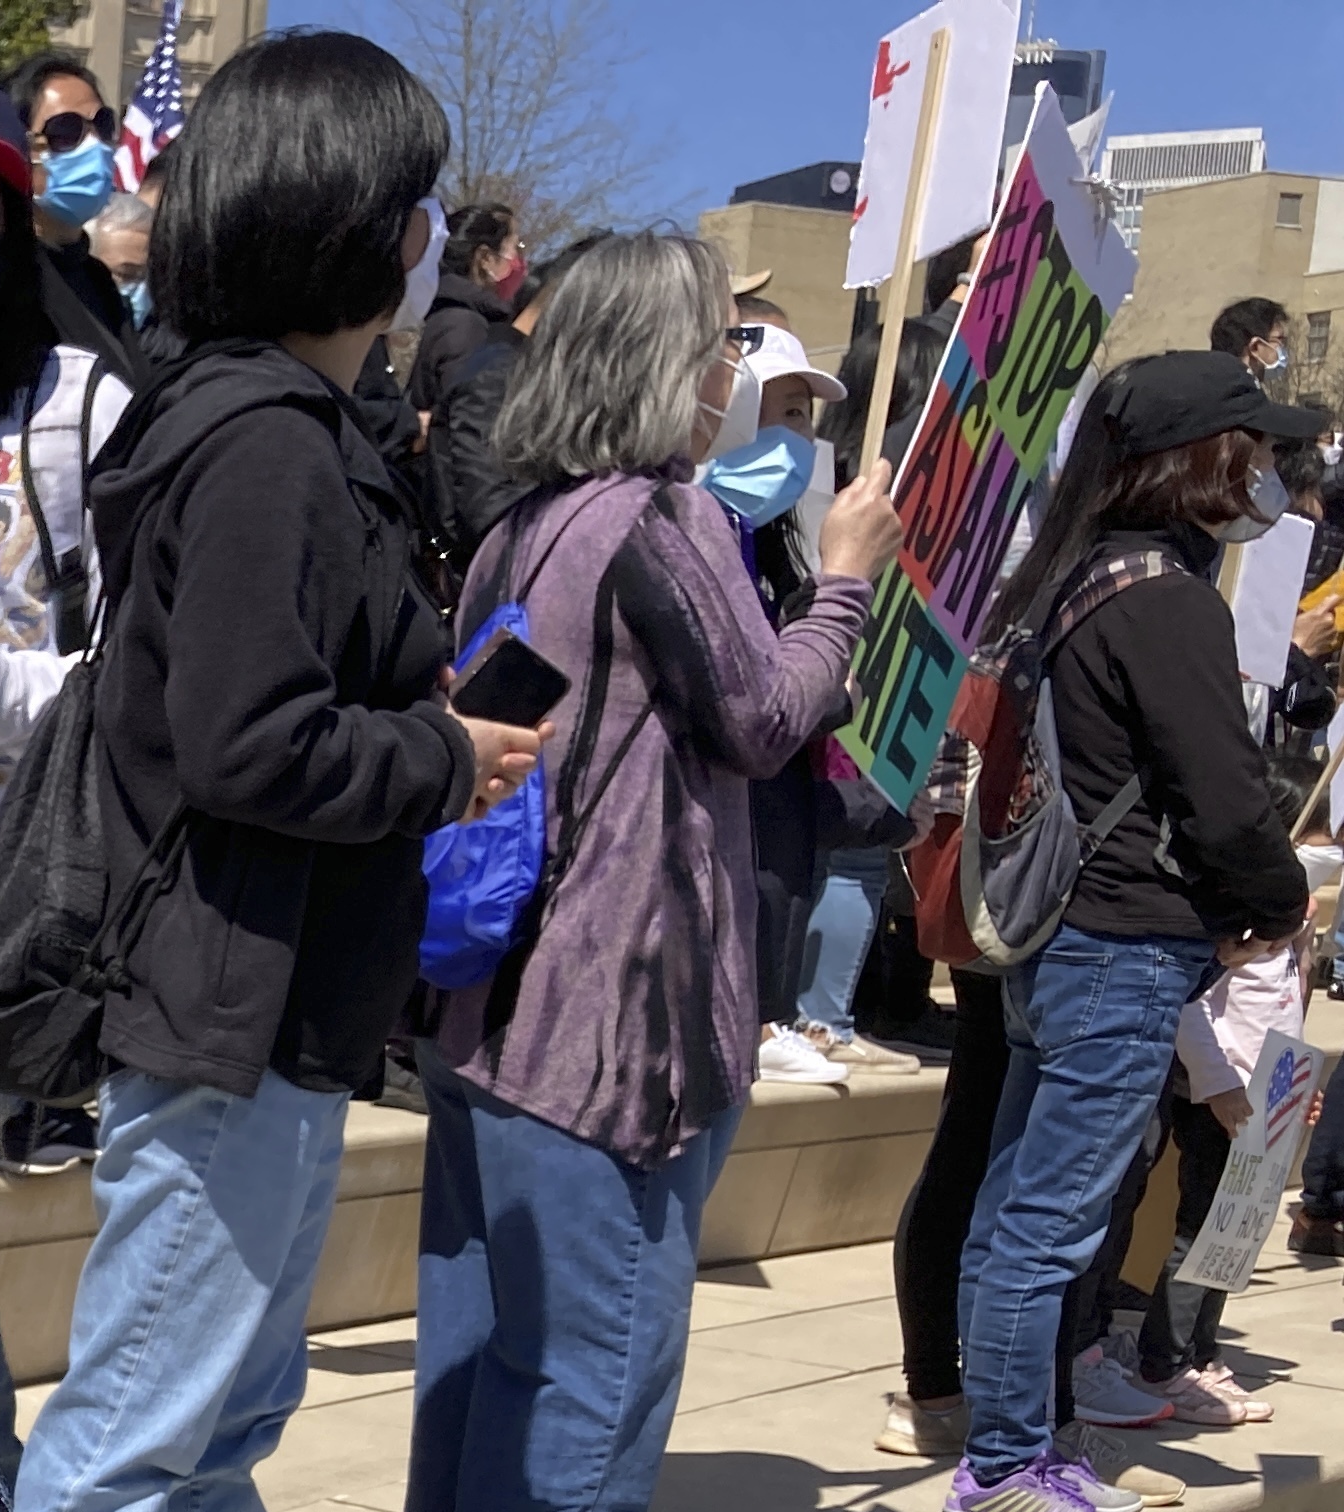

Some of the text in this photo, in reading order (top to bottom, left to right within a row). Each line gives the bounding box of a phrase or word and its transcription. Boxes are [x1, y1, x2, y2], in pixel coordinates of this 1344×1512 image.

[979, 179, 1103, 454] #STOP
[894, 355, 1033, 642] ASIAN
[1210, 1201, 1270, 1242] NO HOME
[1222, 1151, 1263, 1196] HATE
